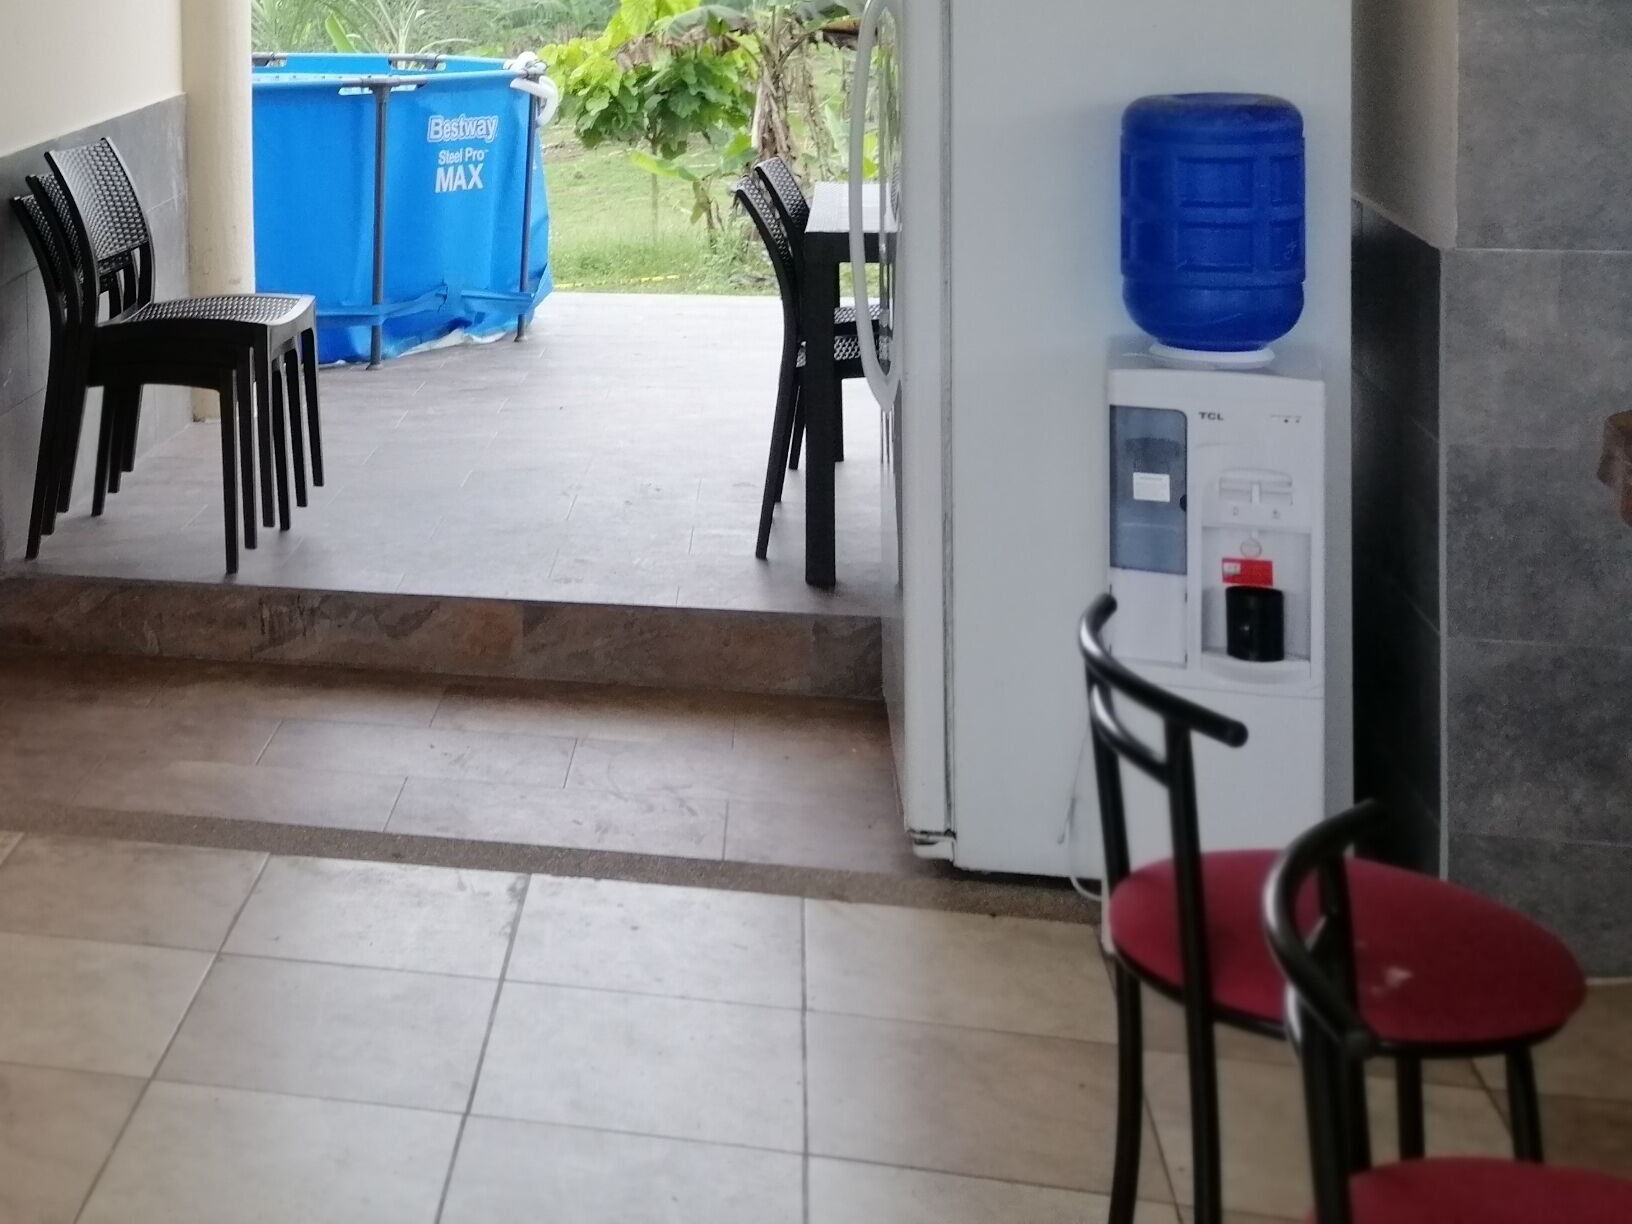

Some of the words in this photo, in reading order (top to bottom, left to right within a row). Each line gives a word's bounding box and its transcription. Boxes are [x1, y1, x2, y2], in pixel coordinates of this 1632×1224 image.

[427, 114, 499, 143] Bestway
[438, 148, 463, 165] Steel
[465, 147, 485, 162] Pro
[435, 163, 484, 193] MAX
[1198, 411, 1224, 421] TCL
